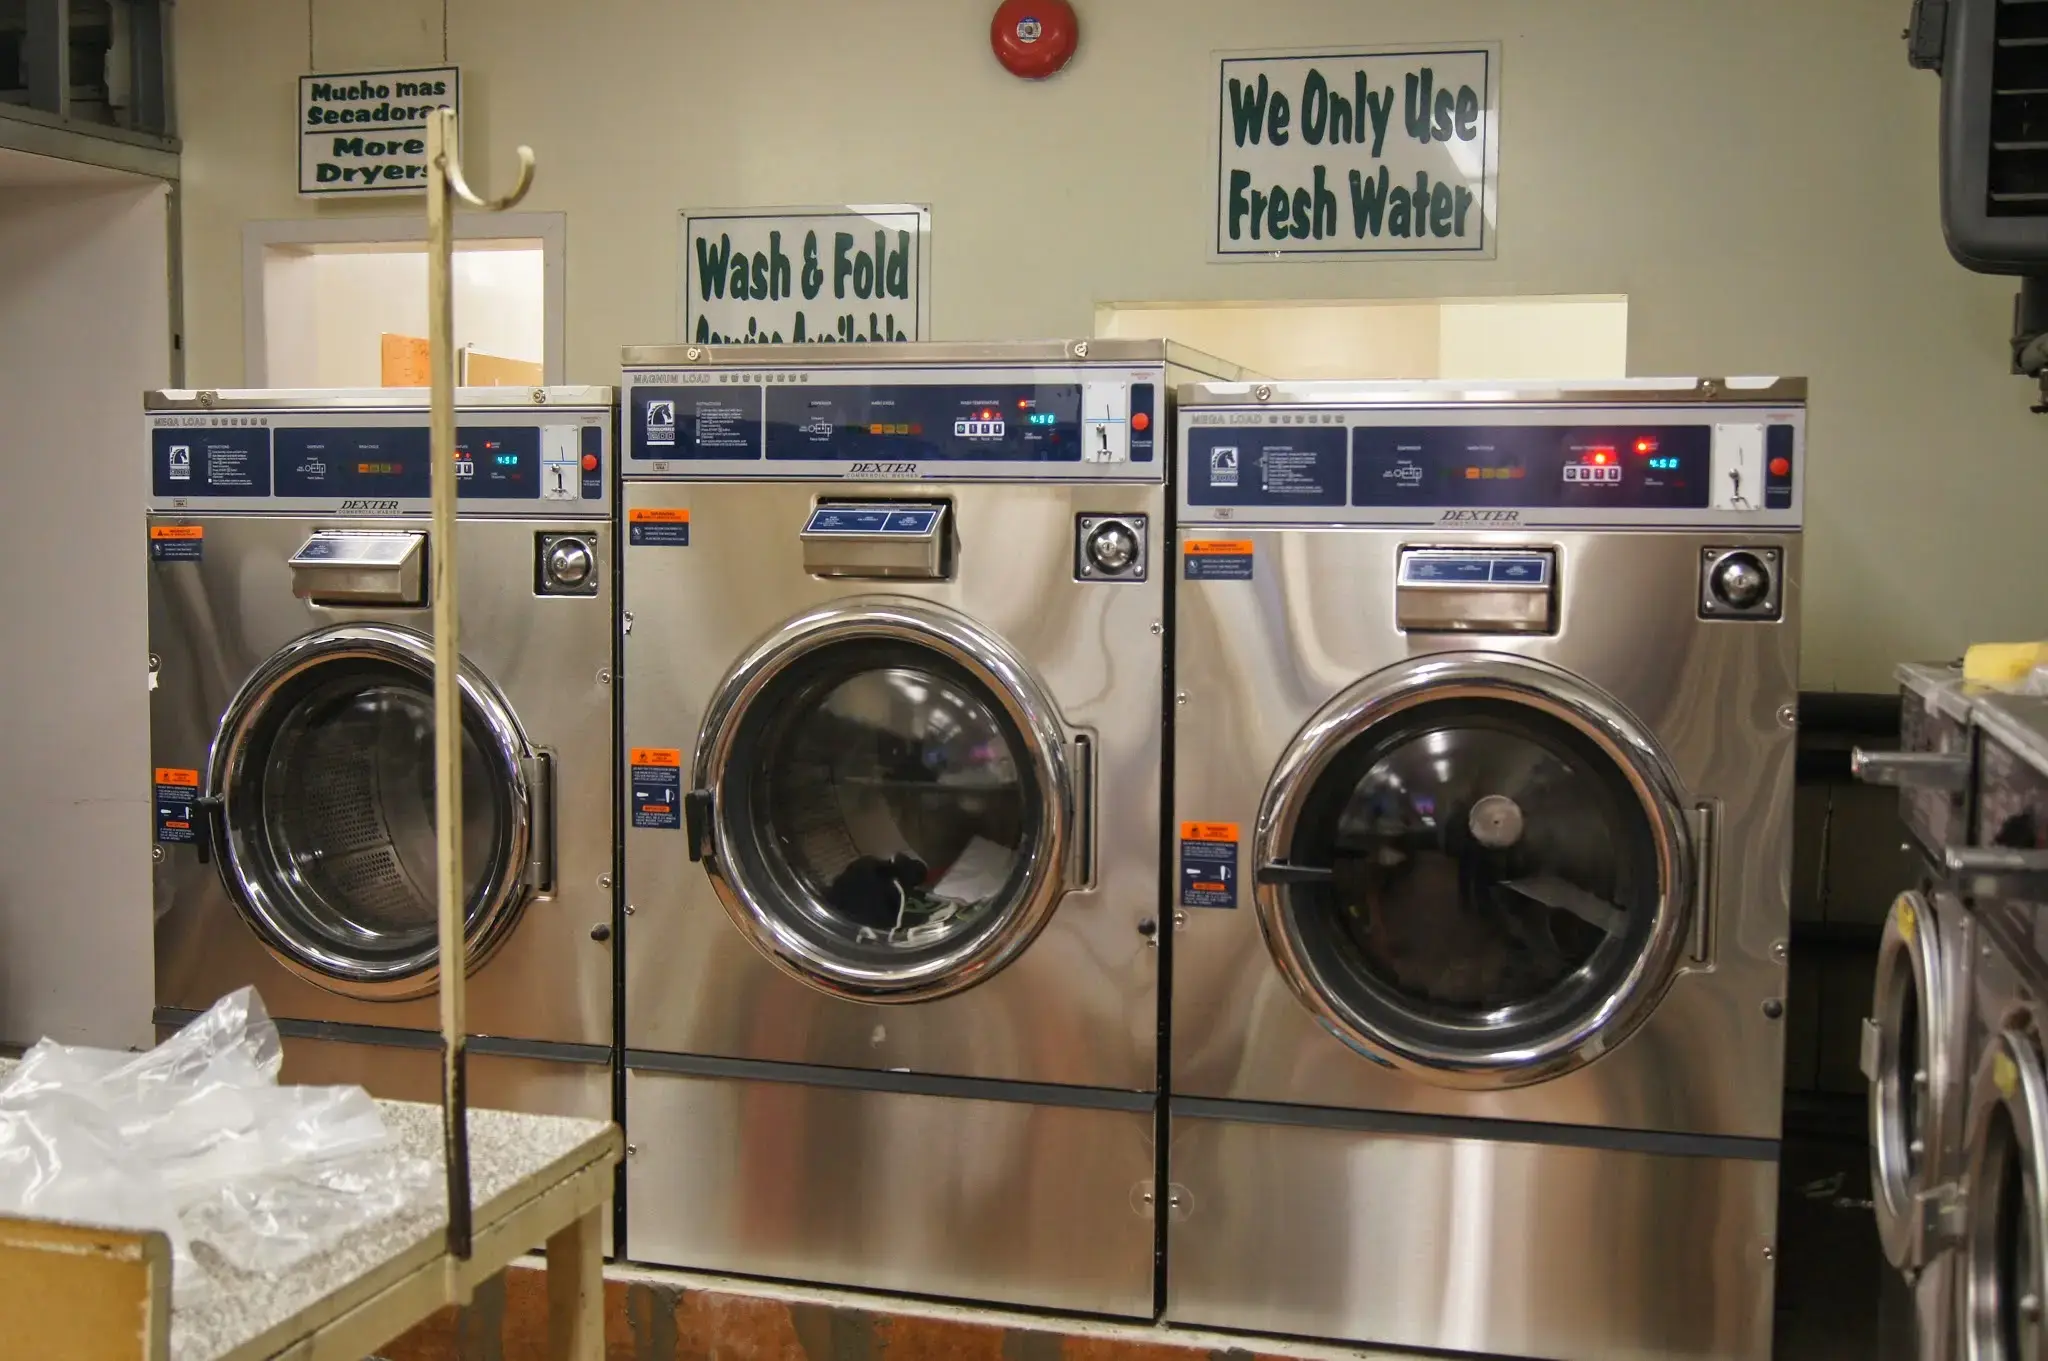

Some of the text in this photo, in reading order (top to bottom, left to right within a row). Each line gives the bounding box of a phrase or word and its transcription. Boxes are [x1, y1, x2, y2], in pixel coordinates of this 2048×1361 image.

[311, 80, 446, 101] Mucho mas
[1229, 67, 1479, 158] We Only Use
[333, 137, 424, 157] More
[1229, 164, 1473, 240] Fresh Water
[696, 229, 910, 301] Wash & Fold
[633, 374, 711, 384] MAGNUM LOAD
[154, 417, 207, 426] MEGA LOAD
[1191, 413, 1263, 425] MEGA LOAD
[848, 462, 917, 473] DEXTER
[341, 500, 399, 509] DEXTER
[1440, 510, 1519, 521] DEXTER
